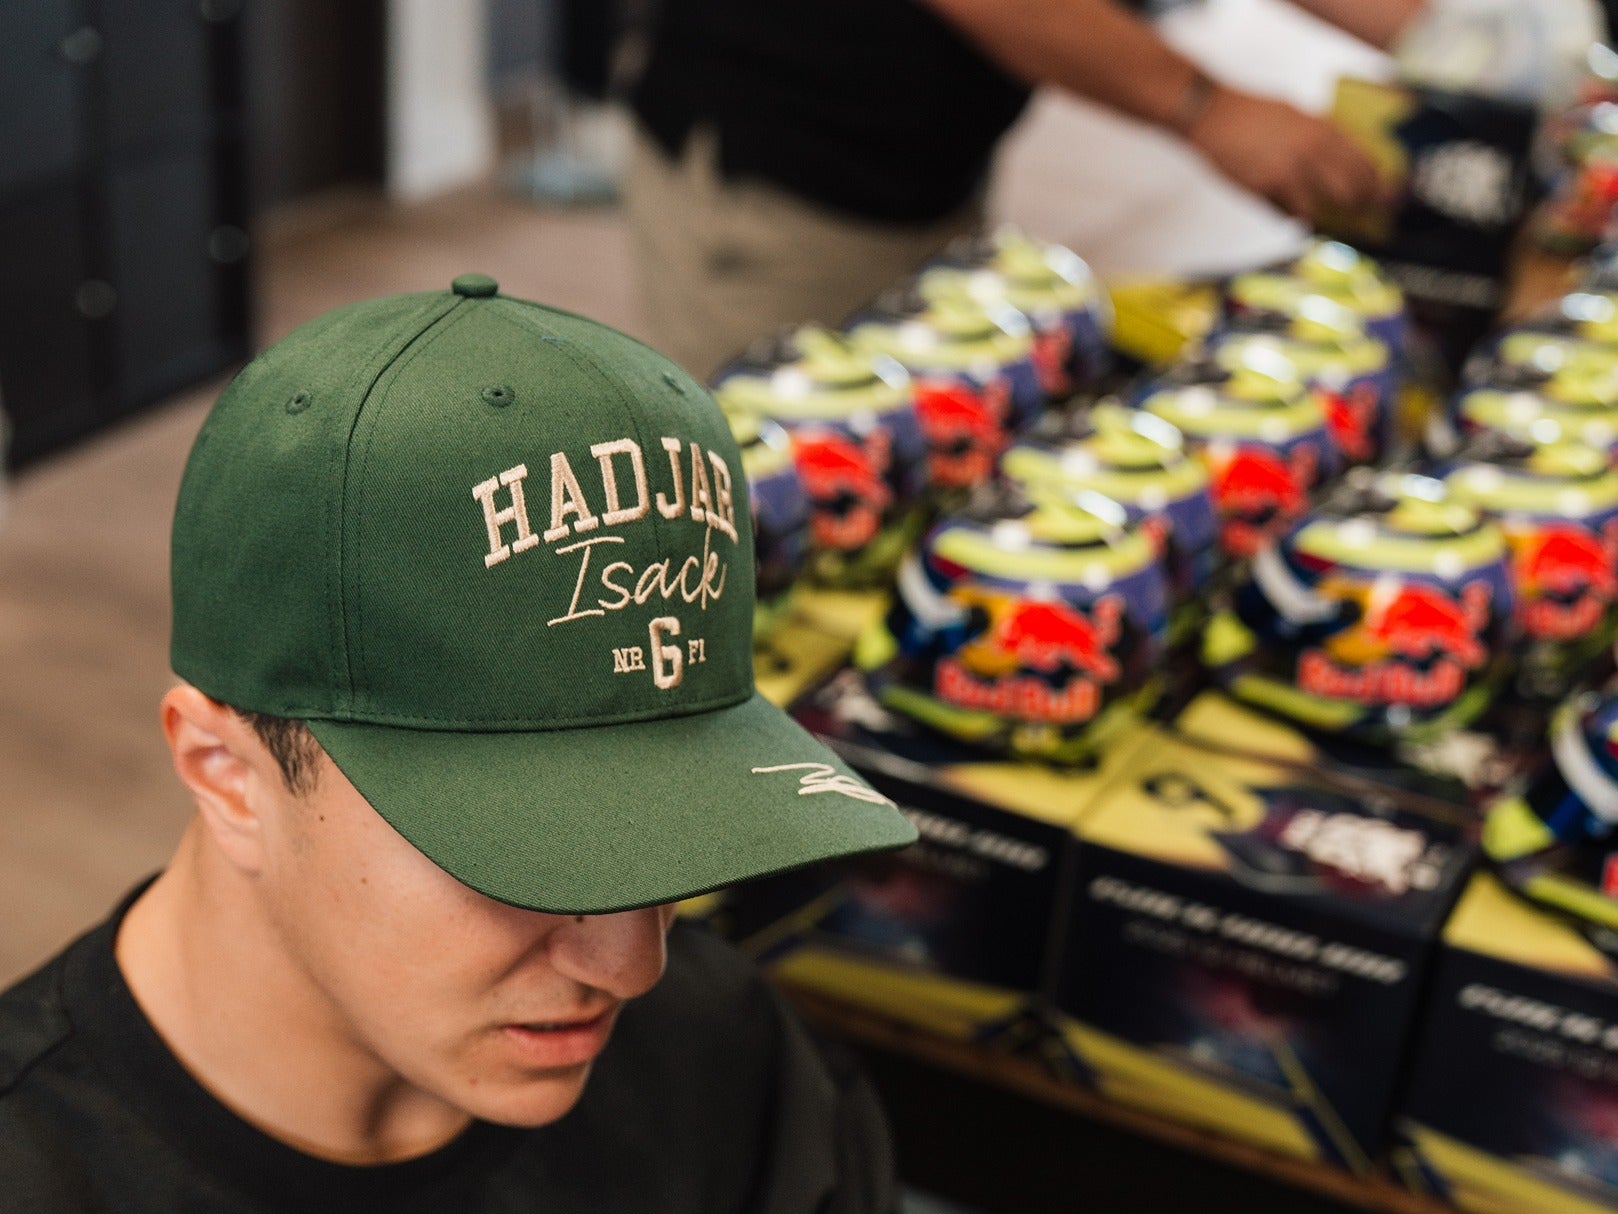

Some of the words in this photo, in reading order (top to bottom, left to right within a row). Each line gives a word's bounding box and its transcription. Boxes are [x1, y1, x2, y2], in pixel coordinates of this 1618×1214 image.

[472, 436, 739, 569] HADJAR
[546, 526, 728, 627] Isack
[612, 645, 646, 673] NR
[648, 616, 683, 690] 6
[688, 638, 706, 665] F1
